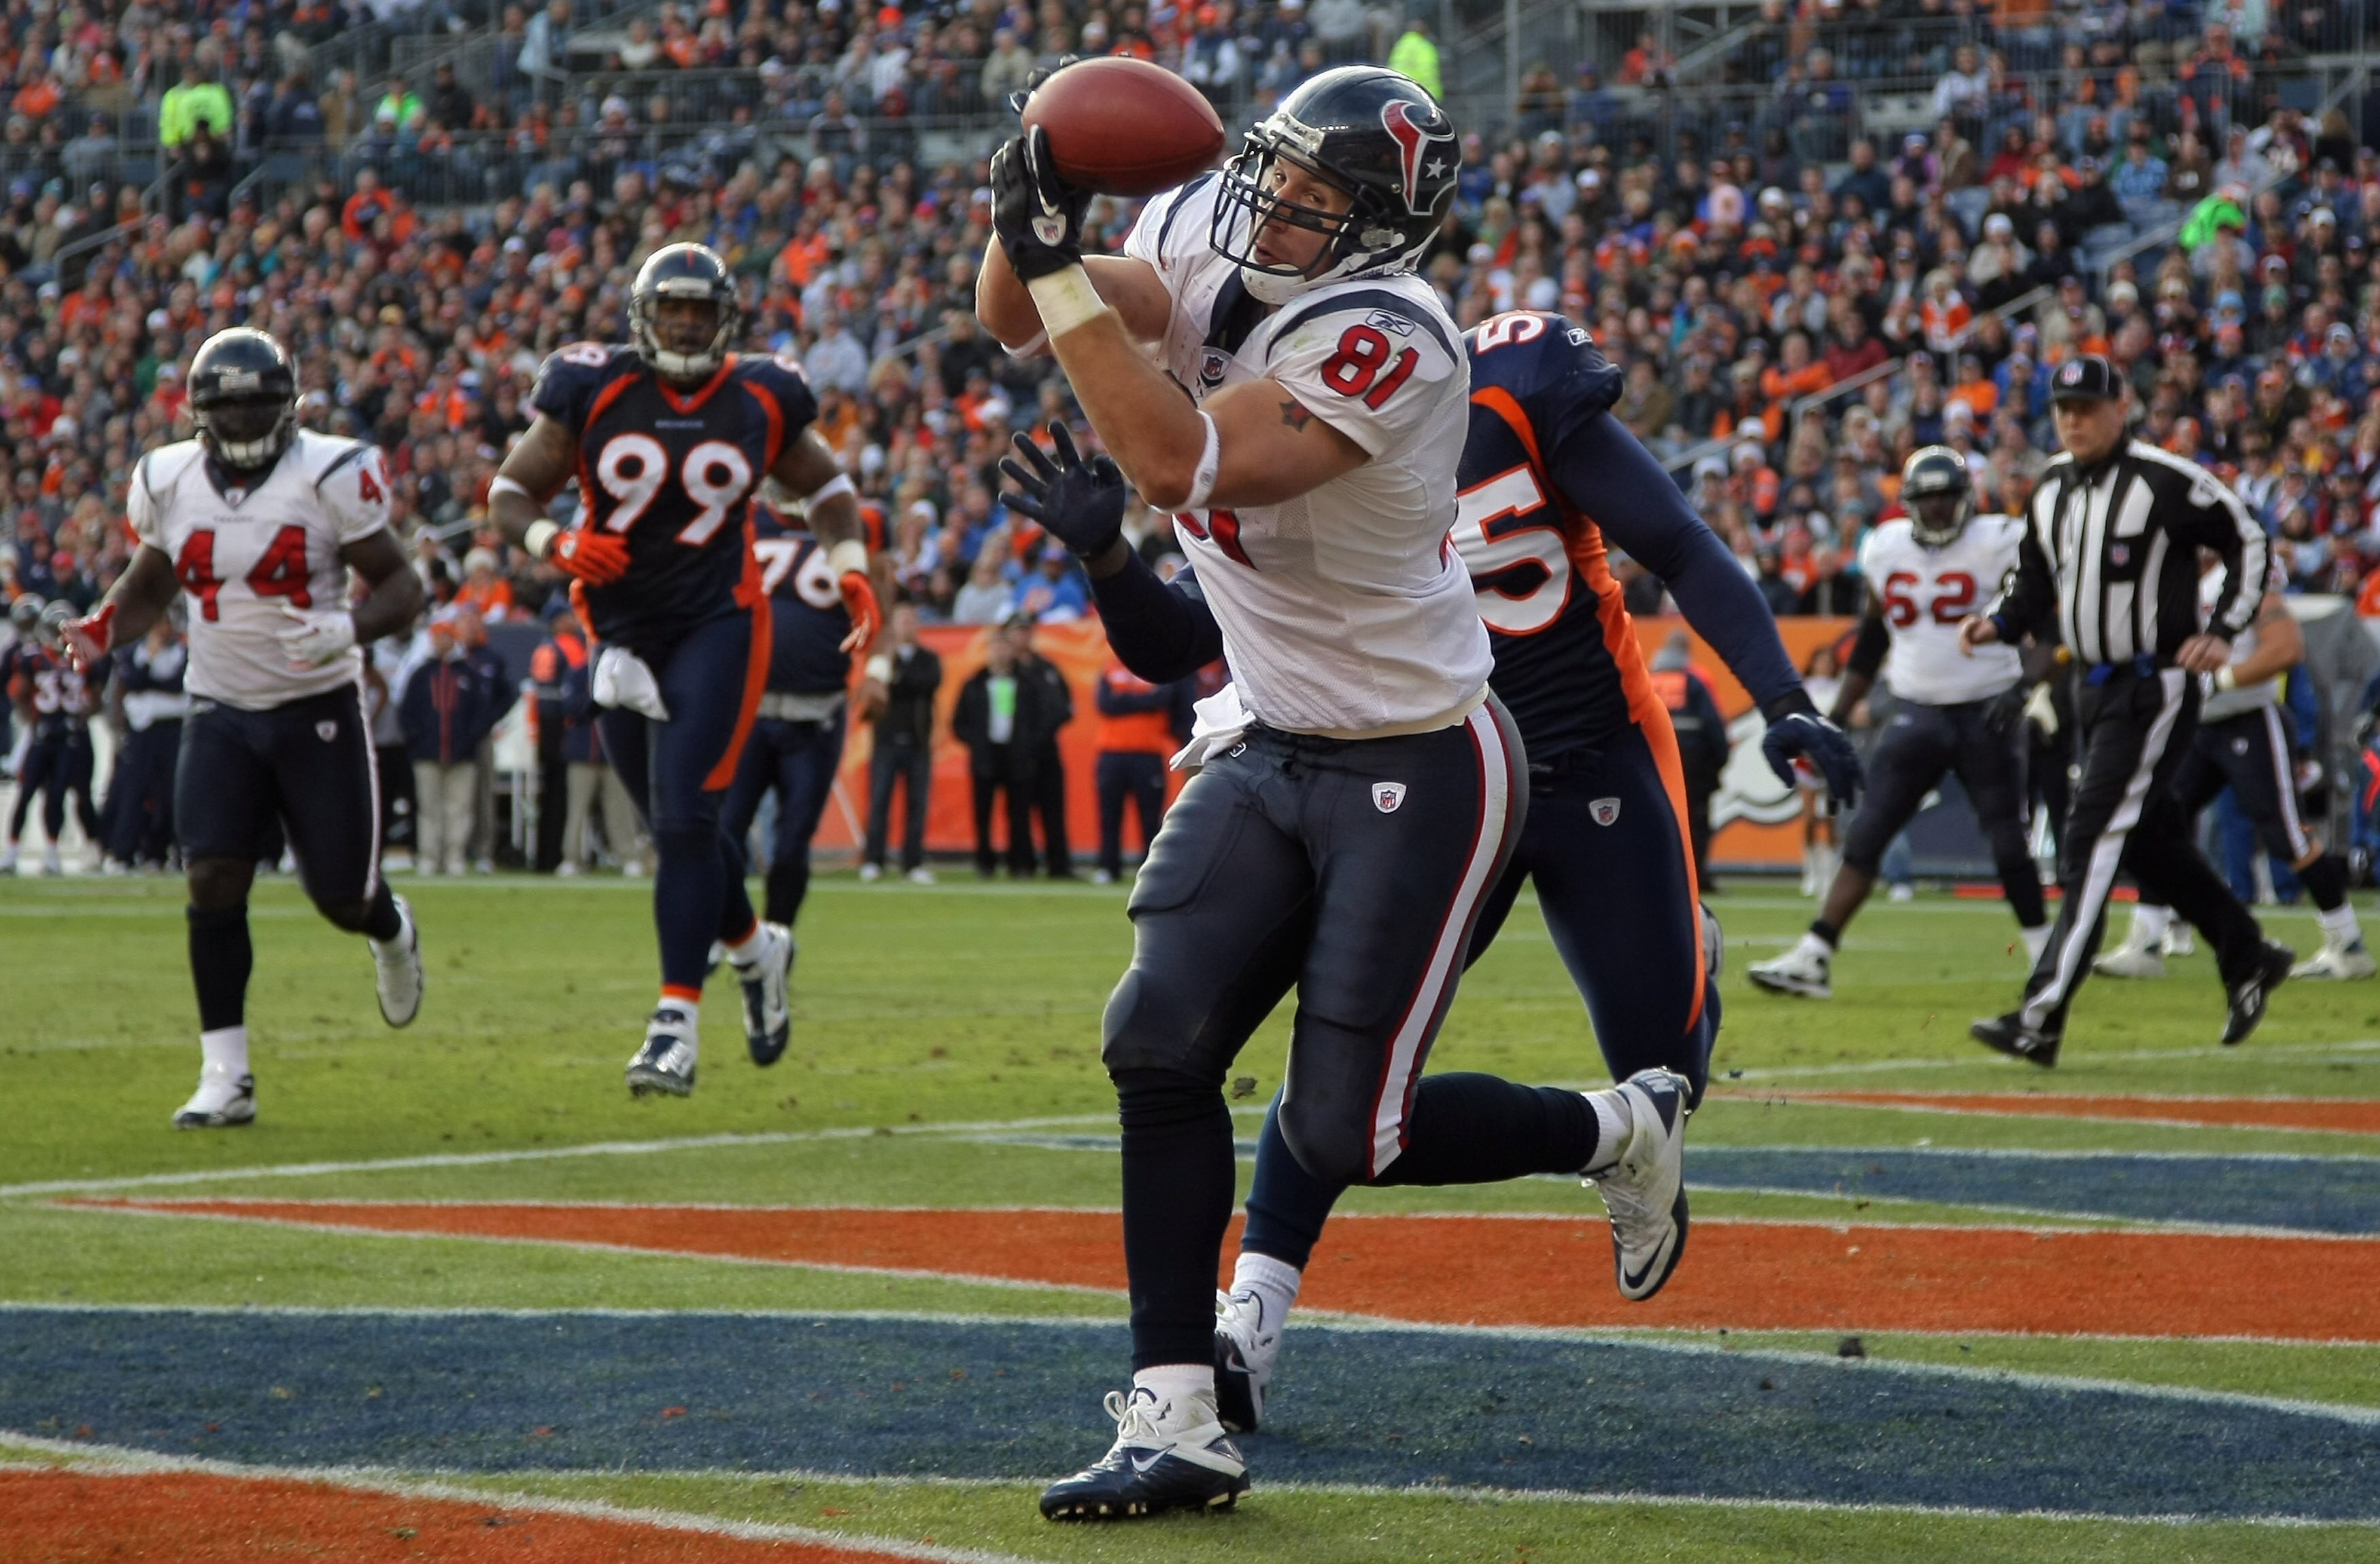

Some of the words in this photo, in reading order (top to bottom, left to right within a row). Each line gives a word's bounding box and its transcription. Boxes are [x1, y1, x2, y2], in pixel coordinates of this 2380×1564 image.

[1321, 324, 1420, 411] 81
[597, 432, 752, 547] 99
[176, 524, 313, 622] 44
[752, 539, 842, 609] 76
[1883, 570, 1977, 630] 62
